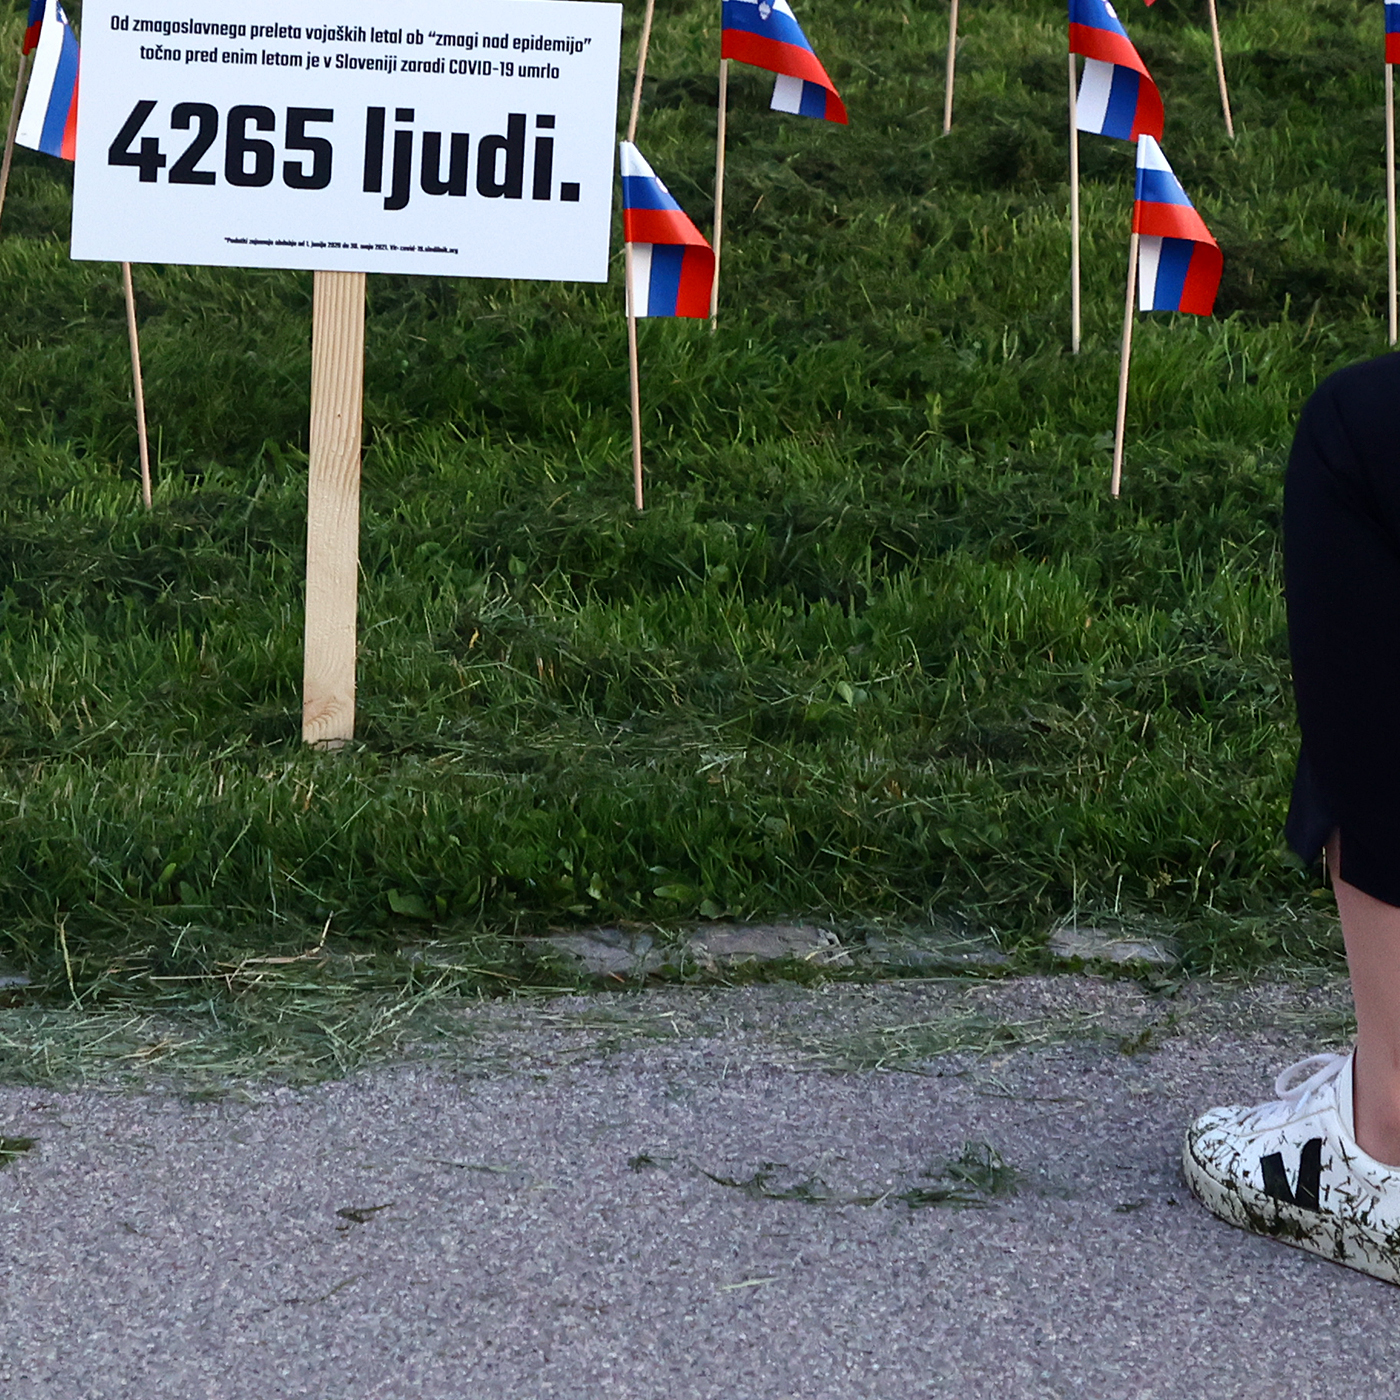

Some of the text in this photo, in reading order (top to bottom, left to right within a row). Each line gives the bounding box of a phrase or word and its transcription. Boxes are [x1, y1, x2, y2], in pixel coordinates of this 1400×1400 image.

[110, 14, 130, 32] Od
[132, 17, 247, 40] zmagoslavnega
[250, 22, 302, 40] preleta
[305, 24, 367, 44] vojaških
[370, 26, 403, 45] letal
[406, 28, 424, 45] ob
[482, 33, 509, 50] nad
[139, 44, 560, 80] točno pred enim letom je v Sloveniji zaradi COVID-19 umrlo
[107, 99, 581, 211] 4265 ljudi.
